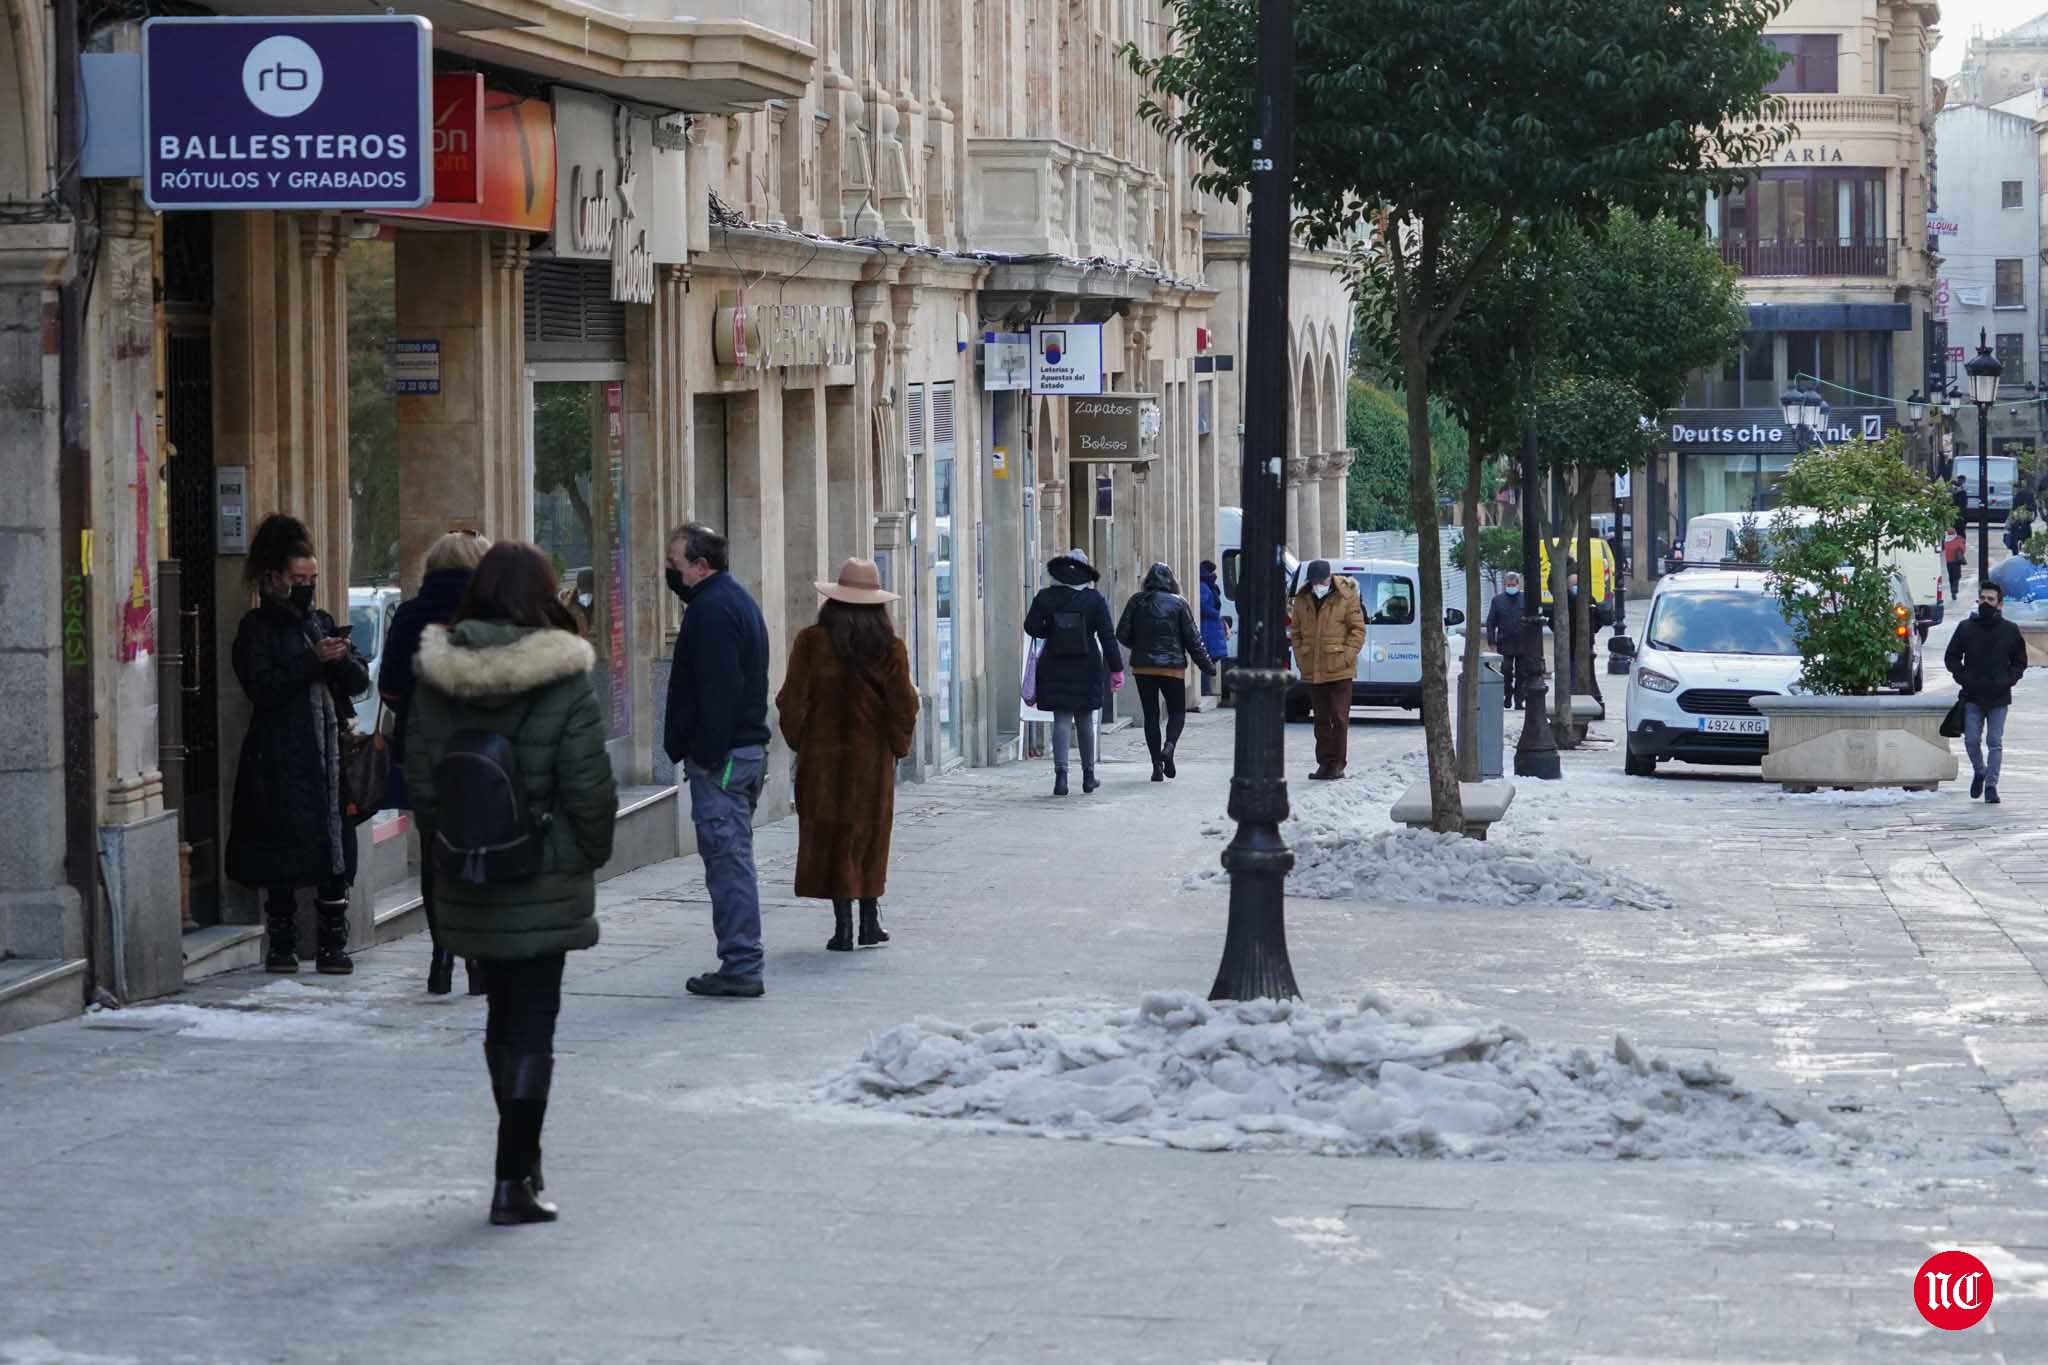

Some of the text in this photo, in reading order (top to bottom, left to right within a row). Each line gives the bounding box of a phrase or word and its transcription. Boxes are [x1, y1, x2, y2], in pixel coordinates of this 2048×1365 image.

[259, 62, 307, 91] rb
[160, 134, 407, 159] BALLESTEROS
[1748, 144, 1843, 162] TARÍA
[161, 168, 407, 189] RÓTULOS Y GRABADOS
[1040, 374, 1072, 382] Apuestas
[1074, 401, 1132, 418] Zapatos
[1672, 424, 1783, 442] Deutsche
[1080, 435, 1128, 450] Bolsos
[1707, 720, 1762, 732] 4924 KRG
